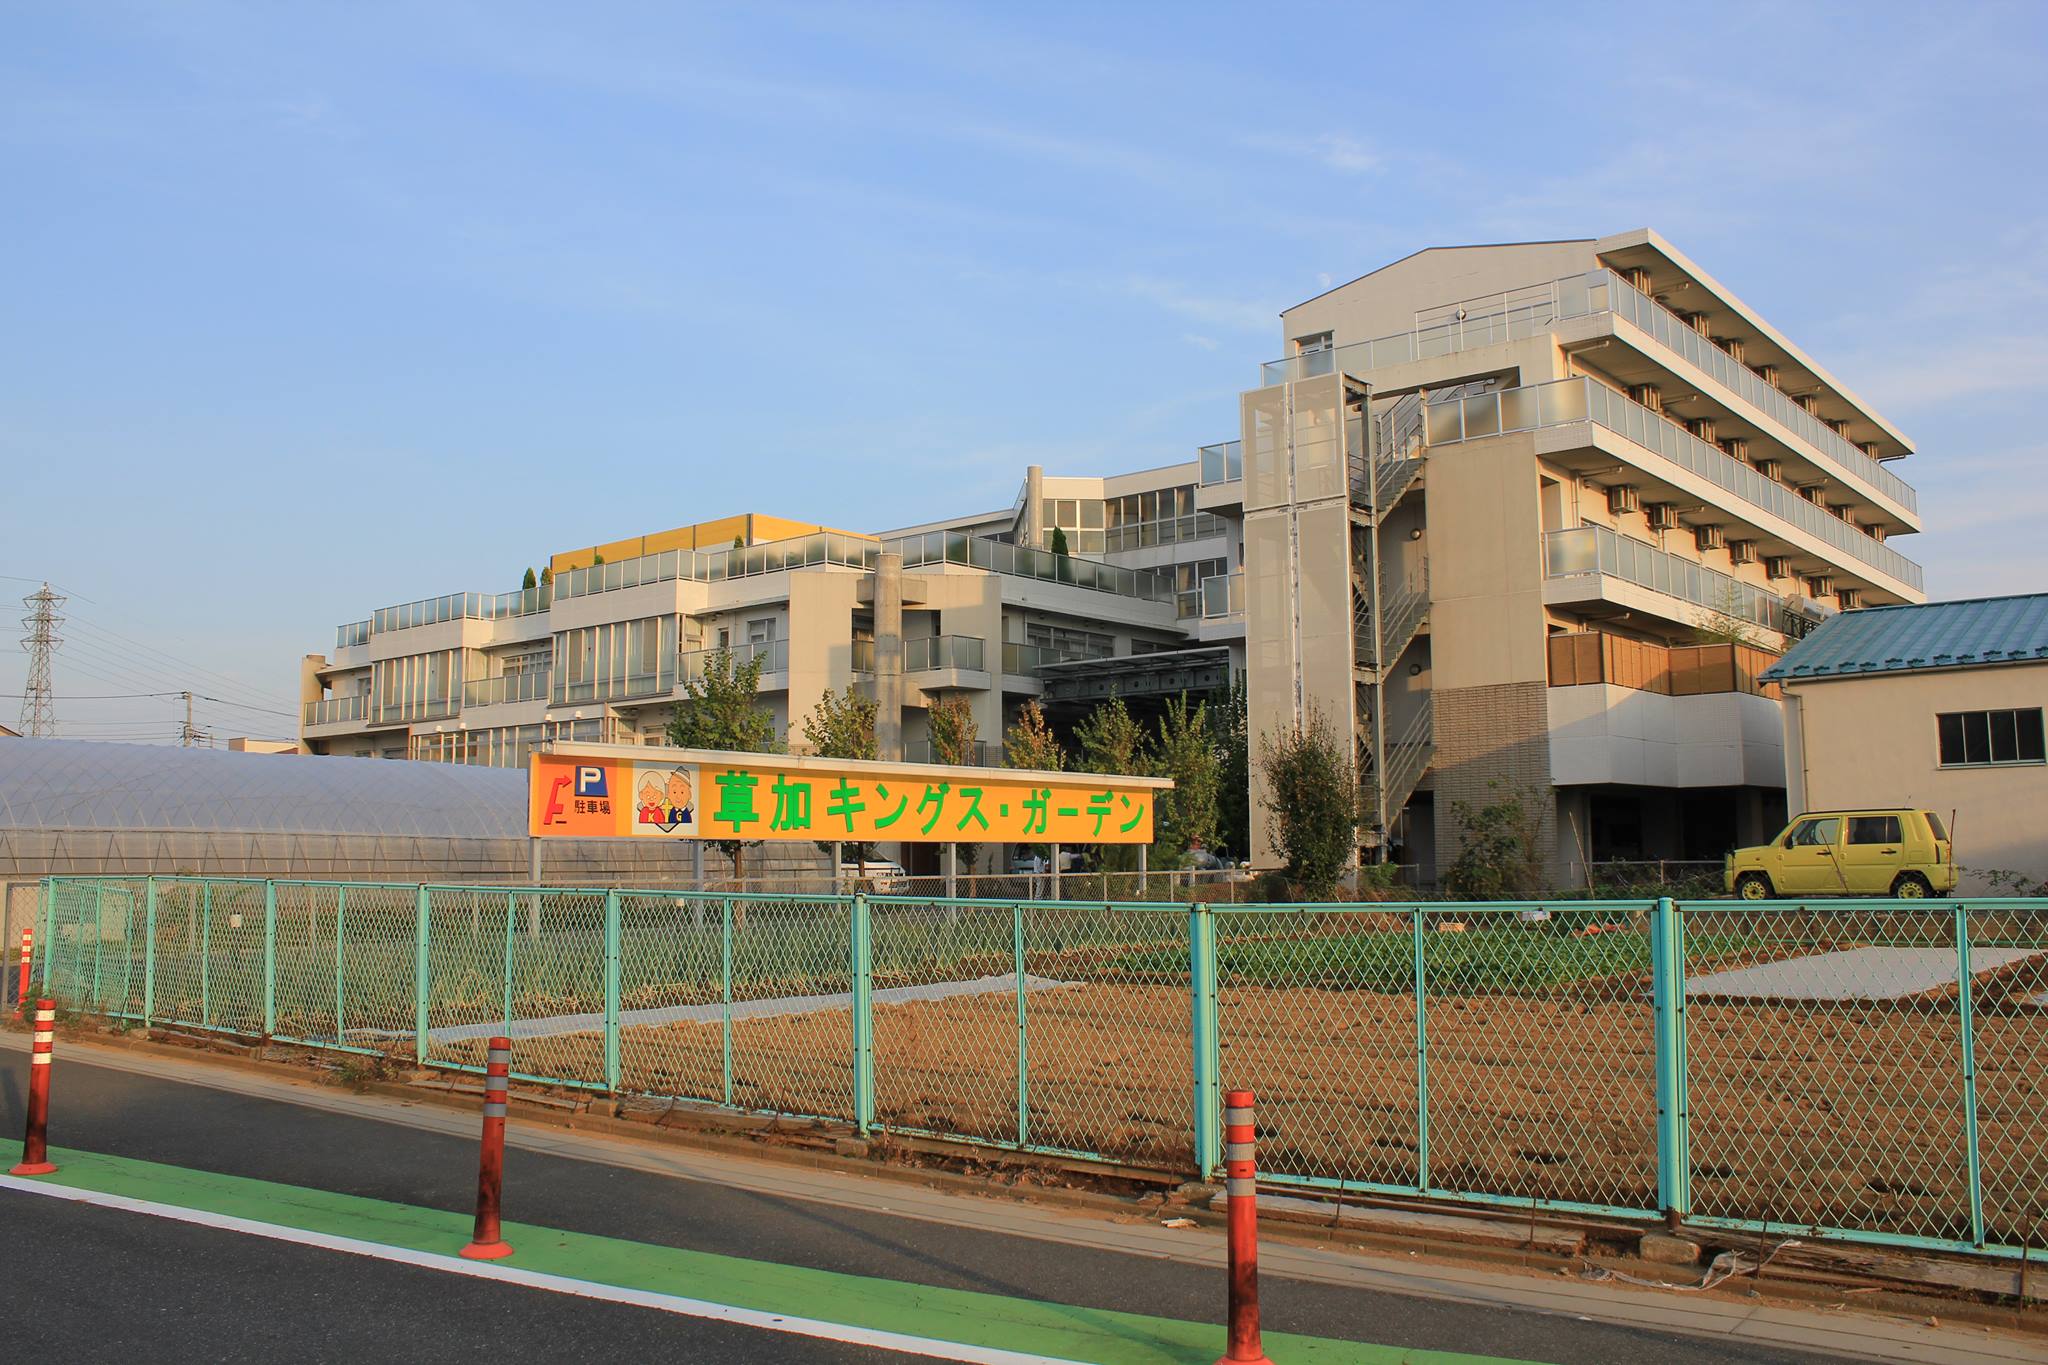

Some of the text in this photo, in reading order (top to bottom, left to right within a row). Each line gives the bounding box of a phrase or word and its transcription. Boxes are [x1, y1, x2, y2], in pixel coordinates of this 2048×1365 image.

[580, 767, 602, 793] P
[574, 799, 611, 815] 駐車場
[713, 770, 1145, 837] 草加キングス・ガーデン
[647, 811, 683, 823] K G
